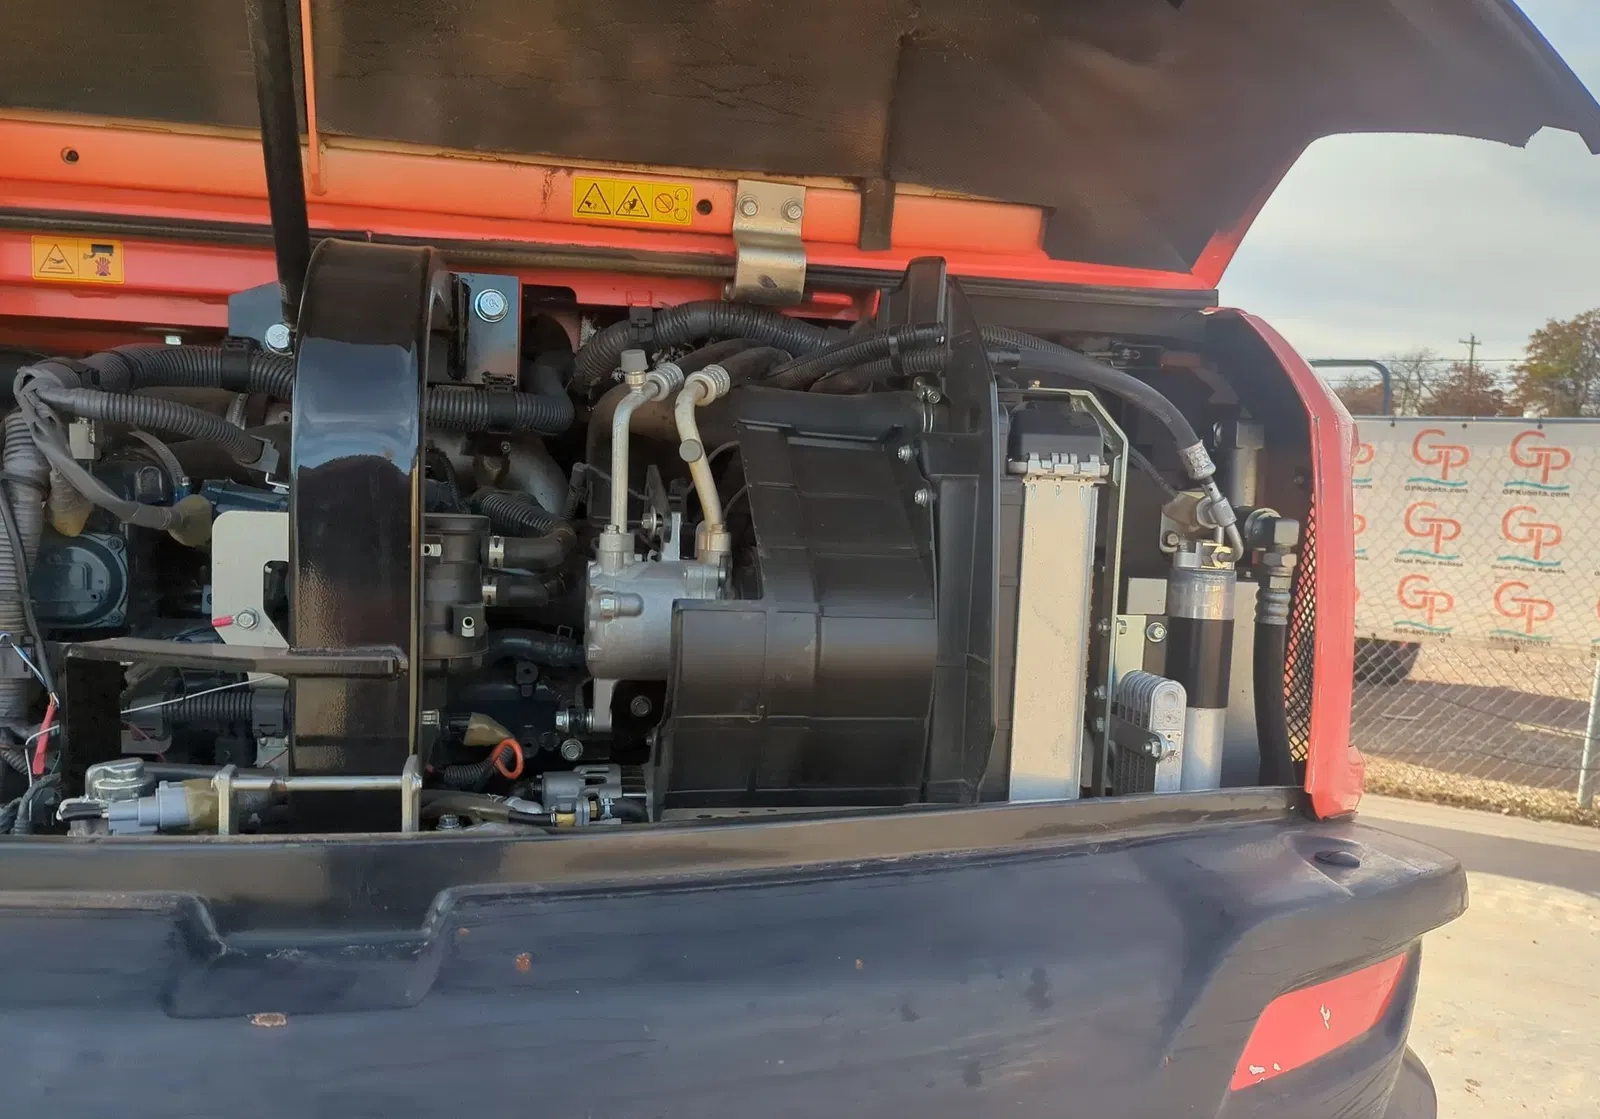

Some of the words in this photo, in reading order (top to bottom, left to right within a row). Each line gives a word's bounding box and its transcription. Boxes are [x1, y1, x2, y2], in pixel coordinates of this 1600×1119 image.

[1412, 428, 1470, 480] GP
[1509, 430, 1571, 484] GP
[1404, 501, 1461, 554] GP
[1502, 505, 1562, 560] GP
[1397, 573, 1454, 625] GP
[1494, 581, 1555, 634] GP
